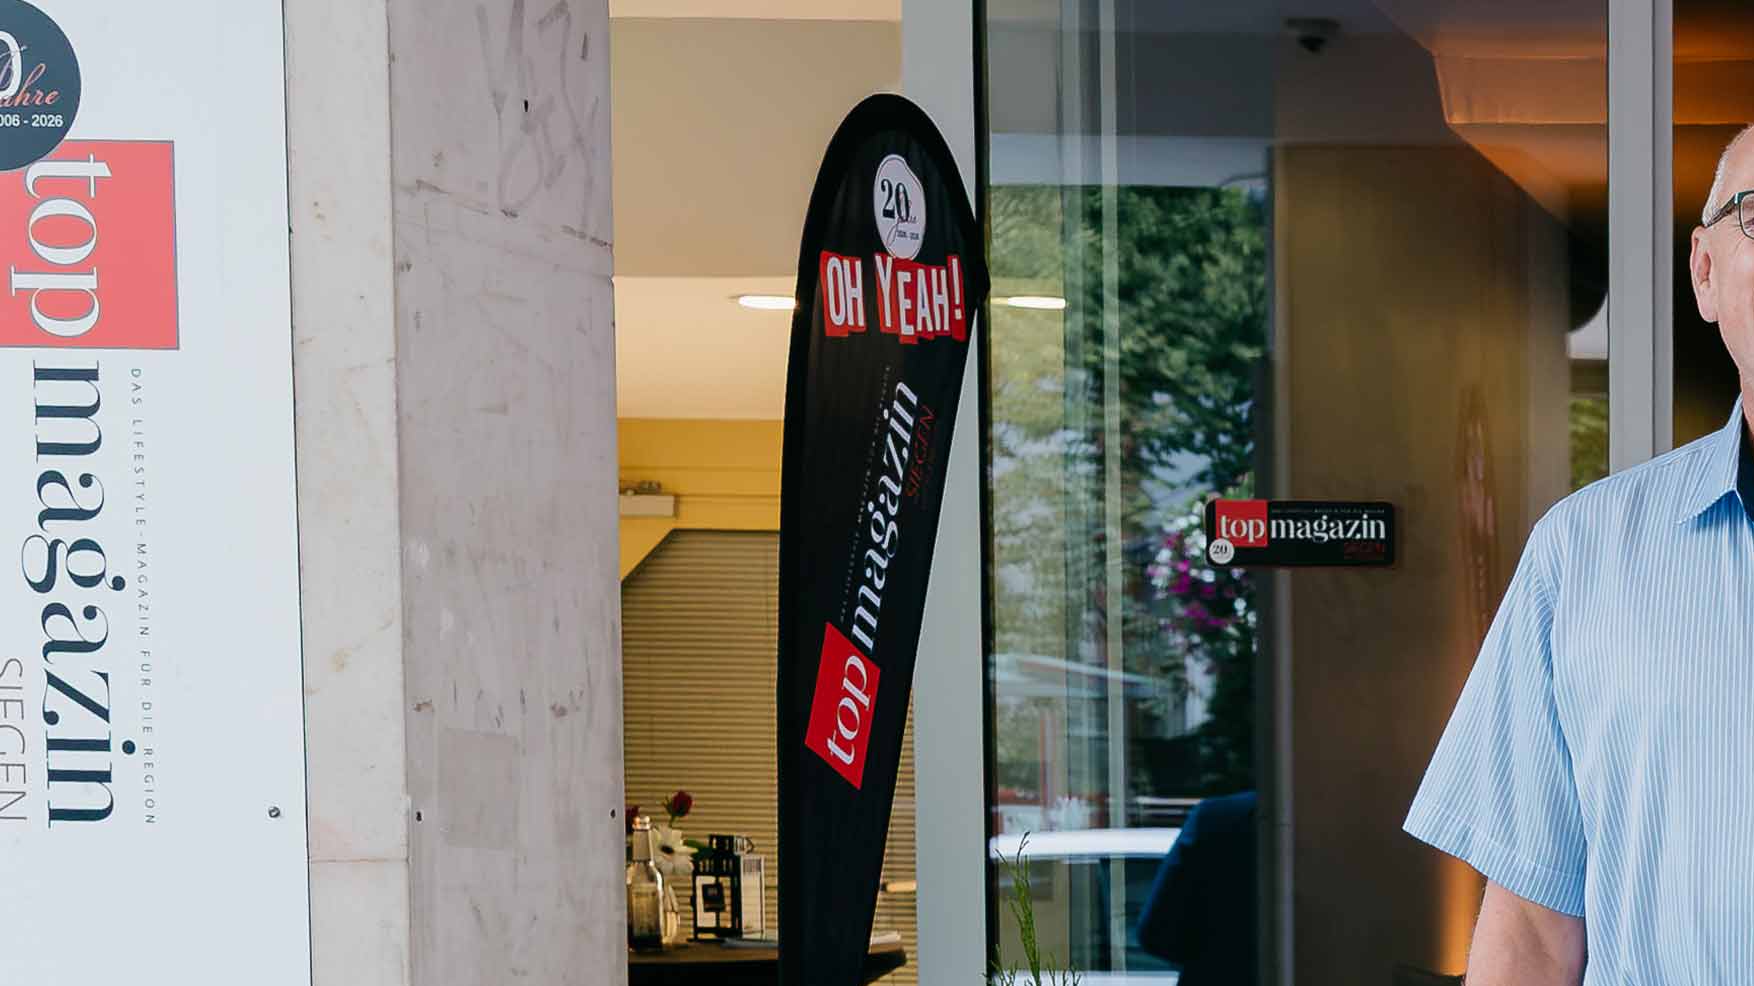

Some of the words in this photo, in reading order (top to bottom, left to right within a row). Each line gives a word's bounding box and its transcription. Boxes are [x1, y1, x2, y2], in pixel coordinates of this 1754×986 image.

[0, 114, 21, 127] 006
[32, 114, 64, 127] 2026
[881, 178, 910, 222] 20
[11, 153, 113, 338] top
[826, 256, 865, 327] OH
[875, 254, 962, 335] YEAH!
[130, 368, 143, 405] DAS
[132, 419, 151, 636] LIFESTYLE-MAGAZIN
[1219, 514, 1266, 543] top
[1270, 513, 1386, 544] magazin
[21, 360, 136, 828] magazin
[826, 654, 872, 766] top
[851, 381, 918, 653] magazin
[142, 702, 153, 733] DIE
[143, 748, 156, 823] REGION
